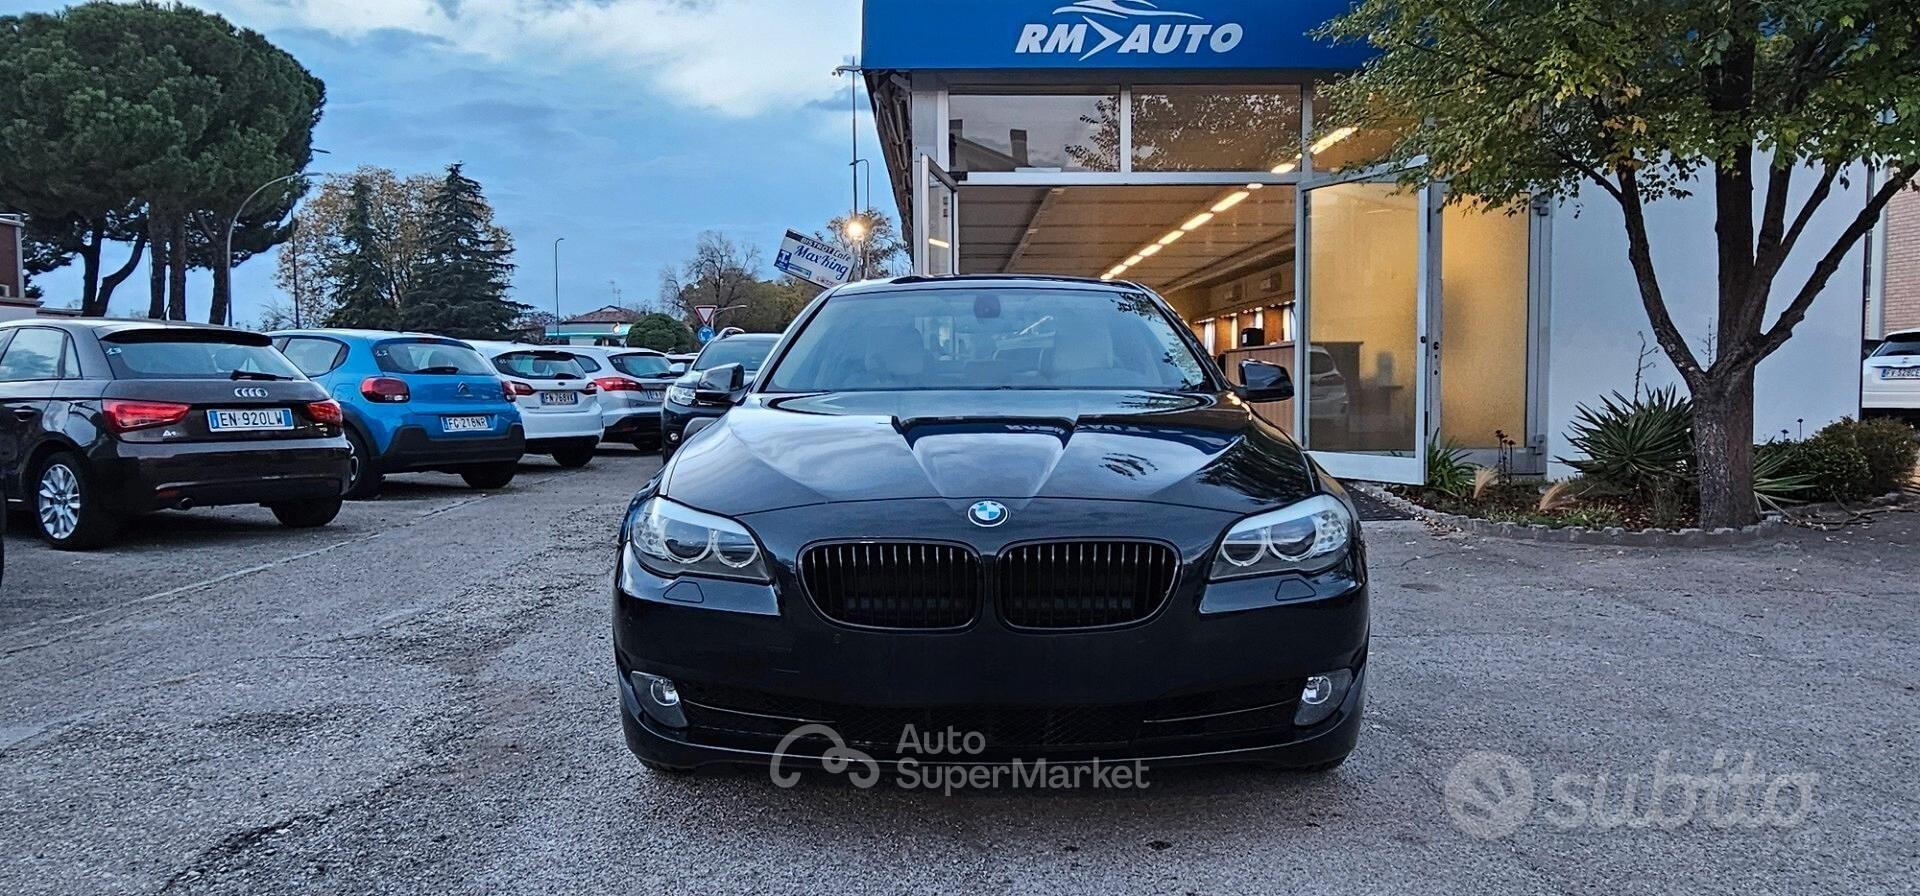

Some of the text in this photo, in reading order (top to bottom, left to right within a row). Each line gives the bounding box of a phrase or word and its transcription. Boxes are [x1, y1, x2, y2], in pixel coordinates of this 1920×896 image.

[1014, 23, 1243, 54] RM AUTO
[219, 411, 283, 426] EN 920LW
